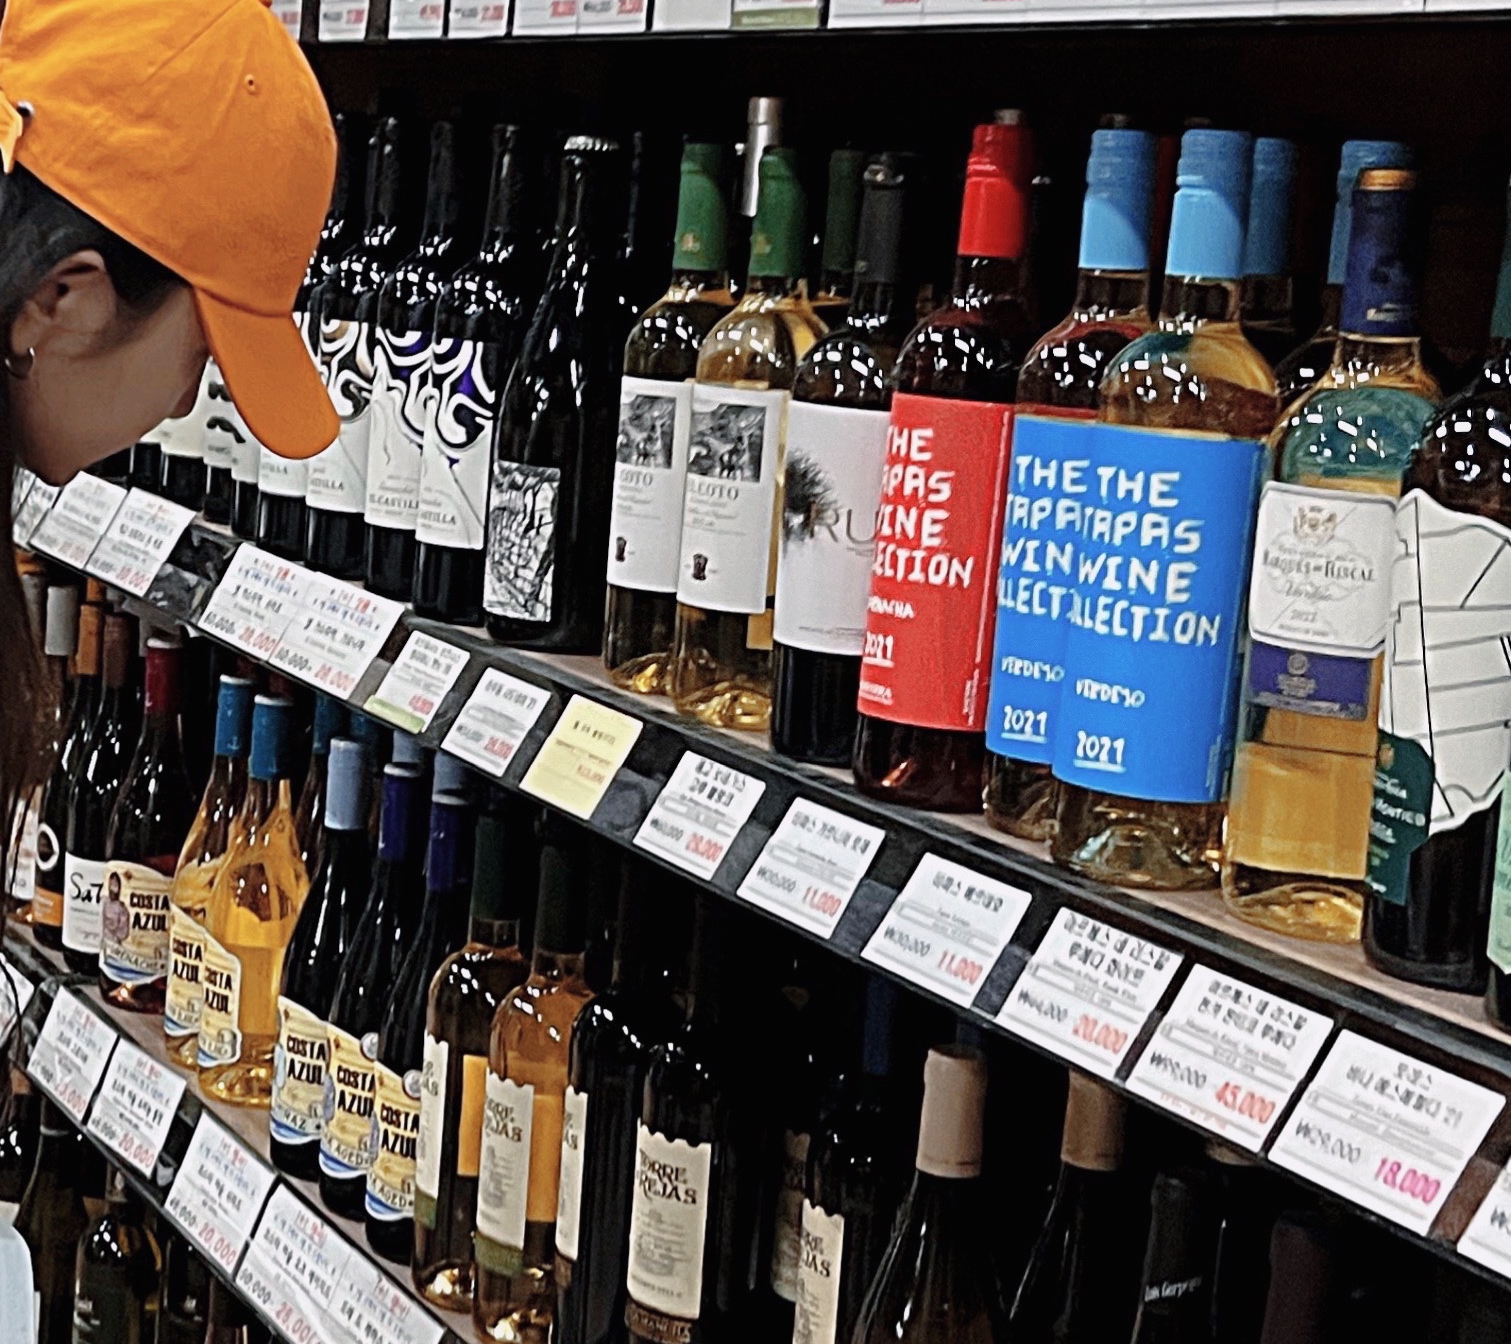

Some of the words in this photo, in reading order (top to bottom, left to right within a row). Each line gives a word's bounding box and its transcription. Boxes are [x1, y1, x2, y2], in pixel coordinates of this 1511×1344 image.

[1015, 454, 1090, 493] THE
[1096, 466, 1181, 508] THE
[1007, 493, 1083, 533] TAPA
[1082, 507, 1206, 555] TAPAS
[1001, 537, 1074, 577] WIN
[1078, 552, 1200, 605] WINE
[1003, 705, 1048, 736] 2021
[1075, 730, 1126, 764] 2021
[129, 891, 170, 912] COSTA
[131, 911, 169, 932] AZUL
[286, 1034, 326, 1062] COSTA
[288, 1059, 325, 1085] AZUL
[1211, 1078, 1278, 1127] 45.000
[1370, 1155, 1444, 1207] 18.000
